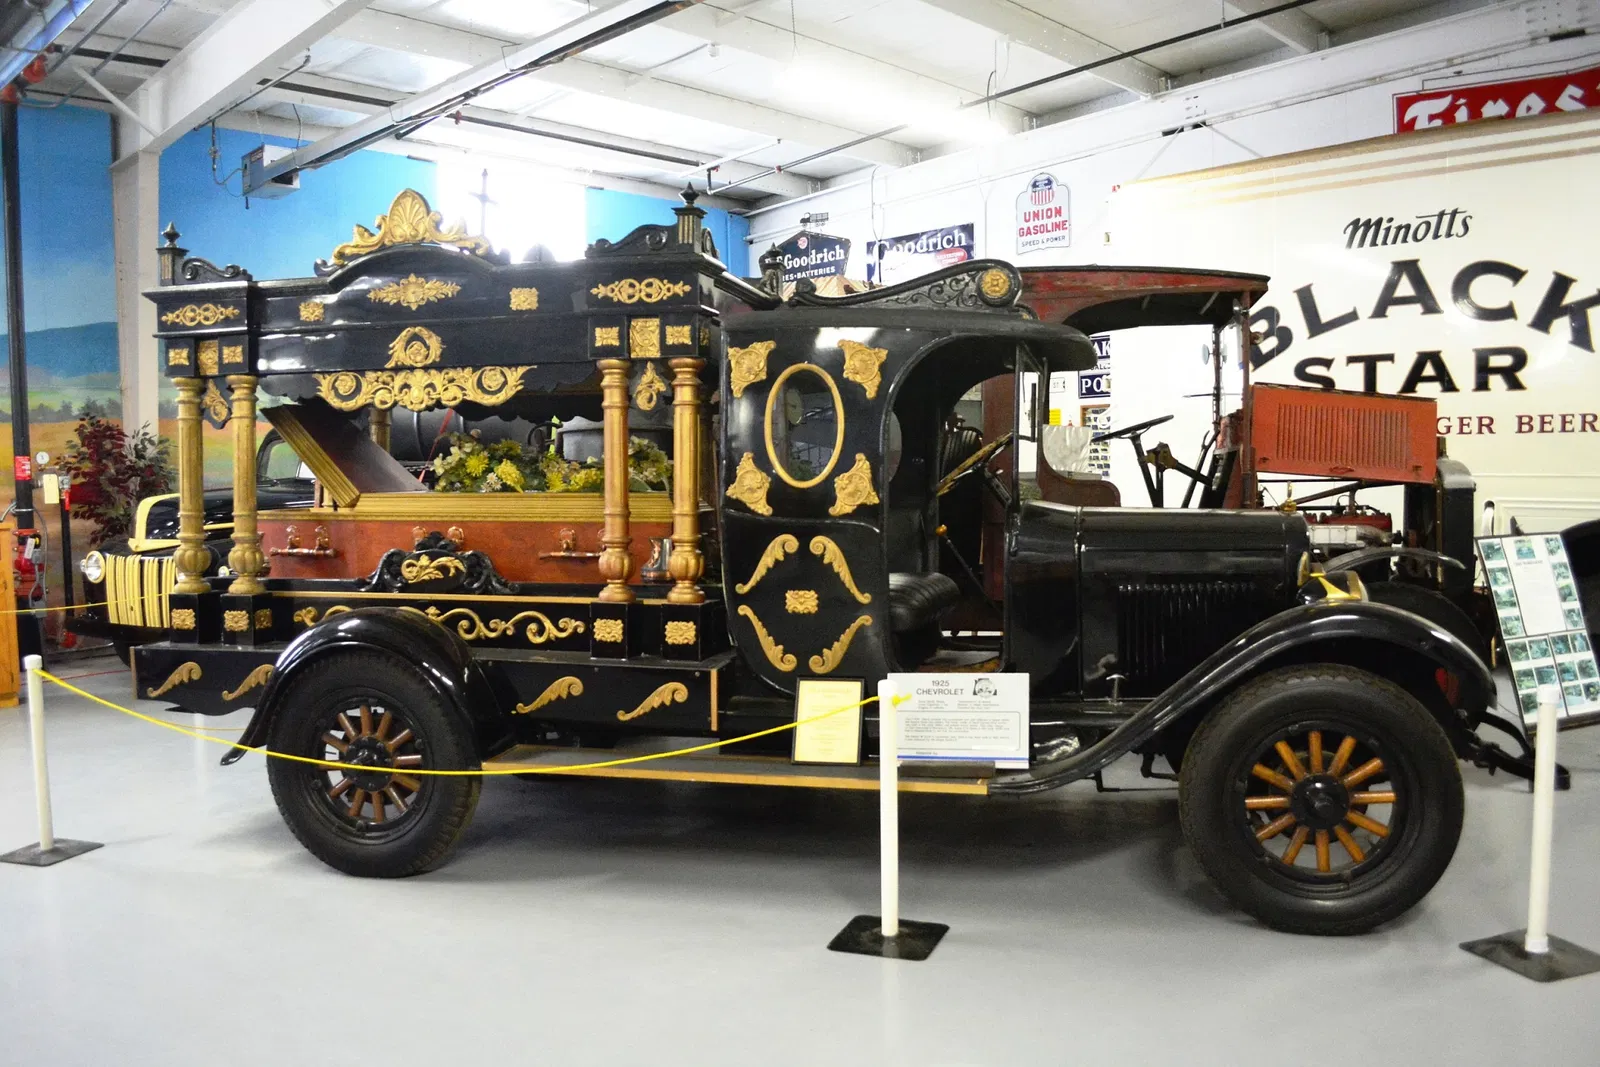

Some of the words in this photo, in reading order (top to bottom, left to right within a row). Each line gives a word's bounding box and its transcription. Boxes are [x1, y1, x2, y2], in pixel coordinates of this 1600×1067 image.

[1404, 81, 1600, 131] Fires
[1024, 206, 1062, 223] UNION
[1018, 220, 1068, 238] GASOLINE
[1343, 207, 1473, 249] Minotts
[872, 229, 967, 262] Goodrich
[1021, 239, 1040, 248] SPEED
[1046, 235, 1066, 244] POWER
[1248, 259, 1600, 372] BLACK
[1294, 346, 1529, 395] STAR
[1515, 413, 1600, 434] BEER
[916, 688, 964, 696] CHEVROLET
[931, 679, 950, 687] 1925
